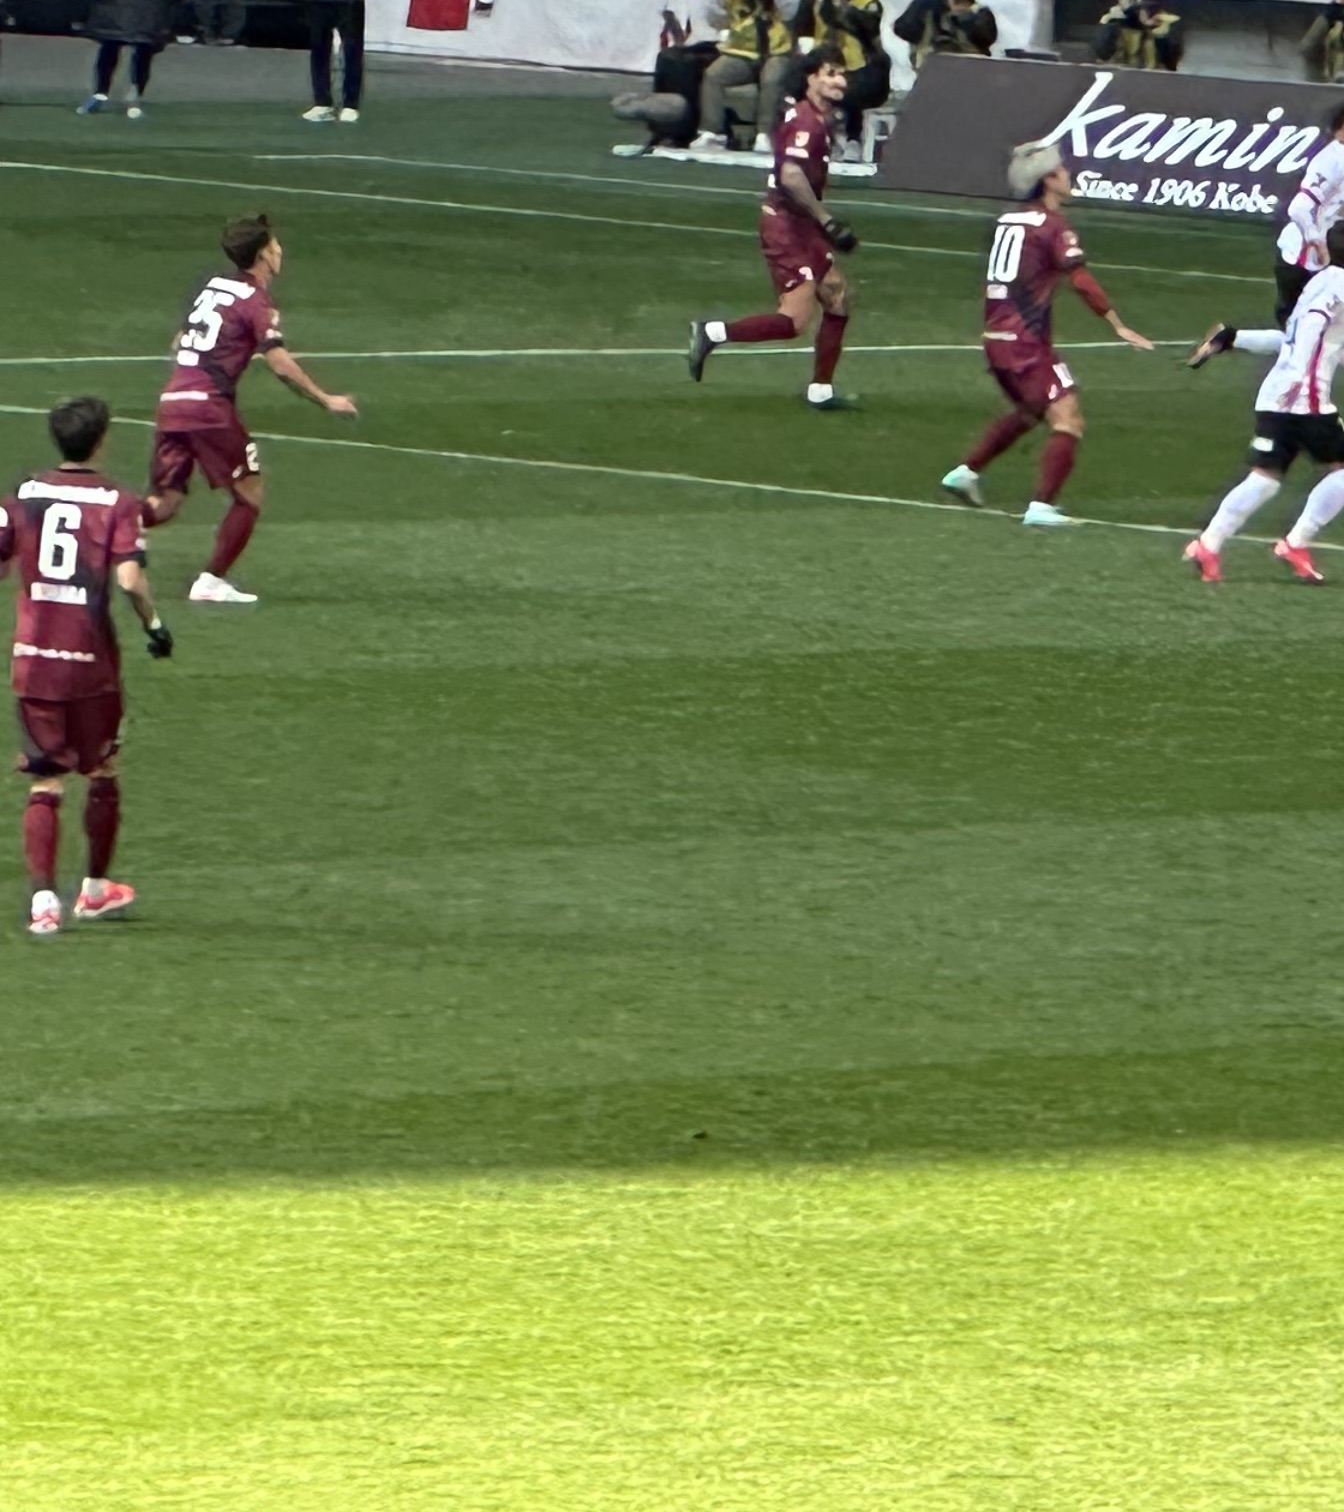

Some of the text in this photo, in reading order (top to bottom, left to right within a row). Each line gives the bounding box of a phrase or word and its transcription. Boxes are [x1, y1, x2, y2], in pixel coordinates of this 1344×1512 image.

[1038, 71, 1322, 174] kamin
[1141, 176, 1212, 208] 1906
[1208, 181, 1279, 214] Kobe
[986, 224, 1026, 284] 10
[37, 502, 83, 581] 6
